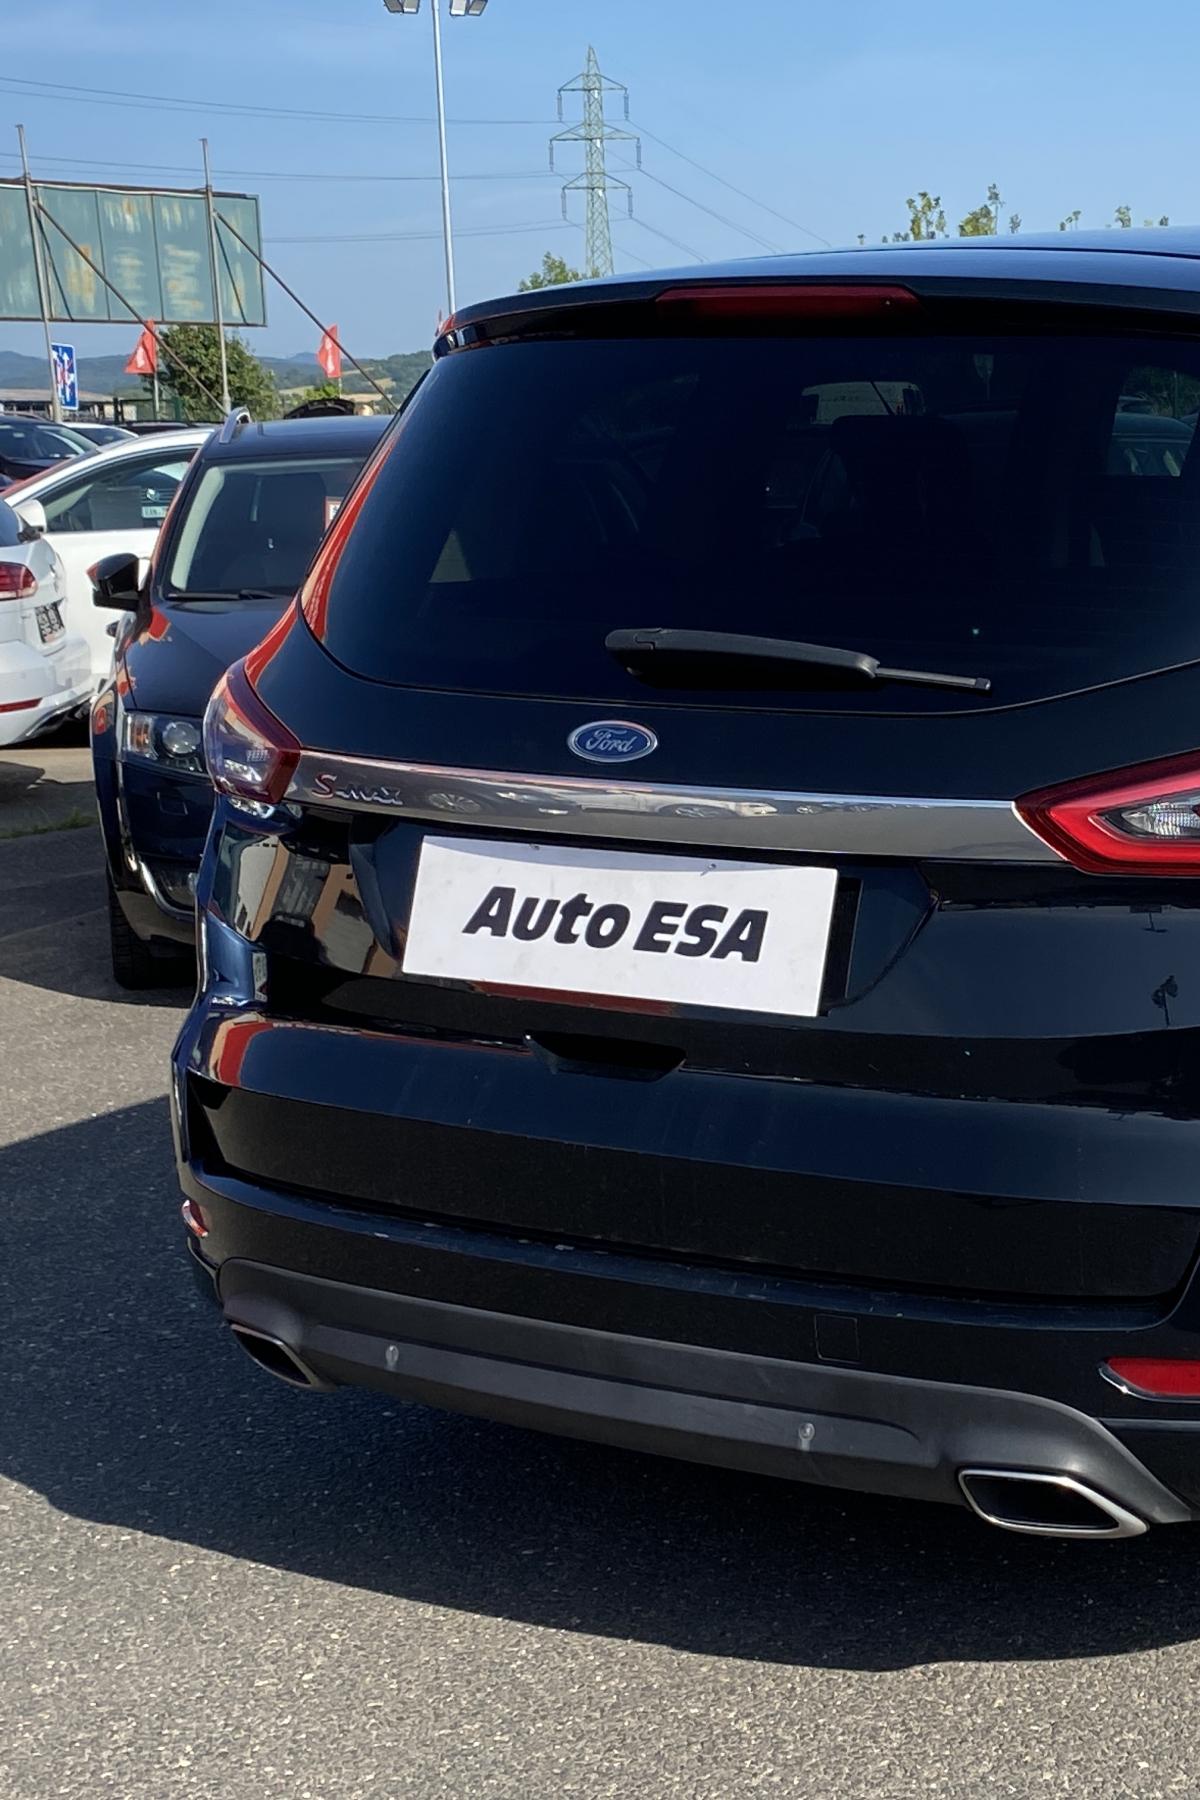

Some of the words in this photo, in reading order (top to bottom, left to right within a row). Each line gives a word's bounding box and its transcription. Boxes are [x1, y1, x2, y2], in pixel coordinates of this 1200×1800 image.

[585, 728, 638, 753] Ford
[461, 885, 631, 949] Auto
[633, 900, 769, 963] ESA
